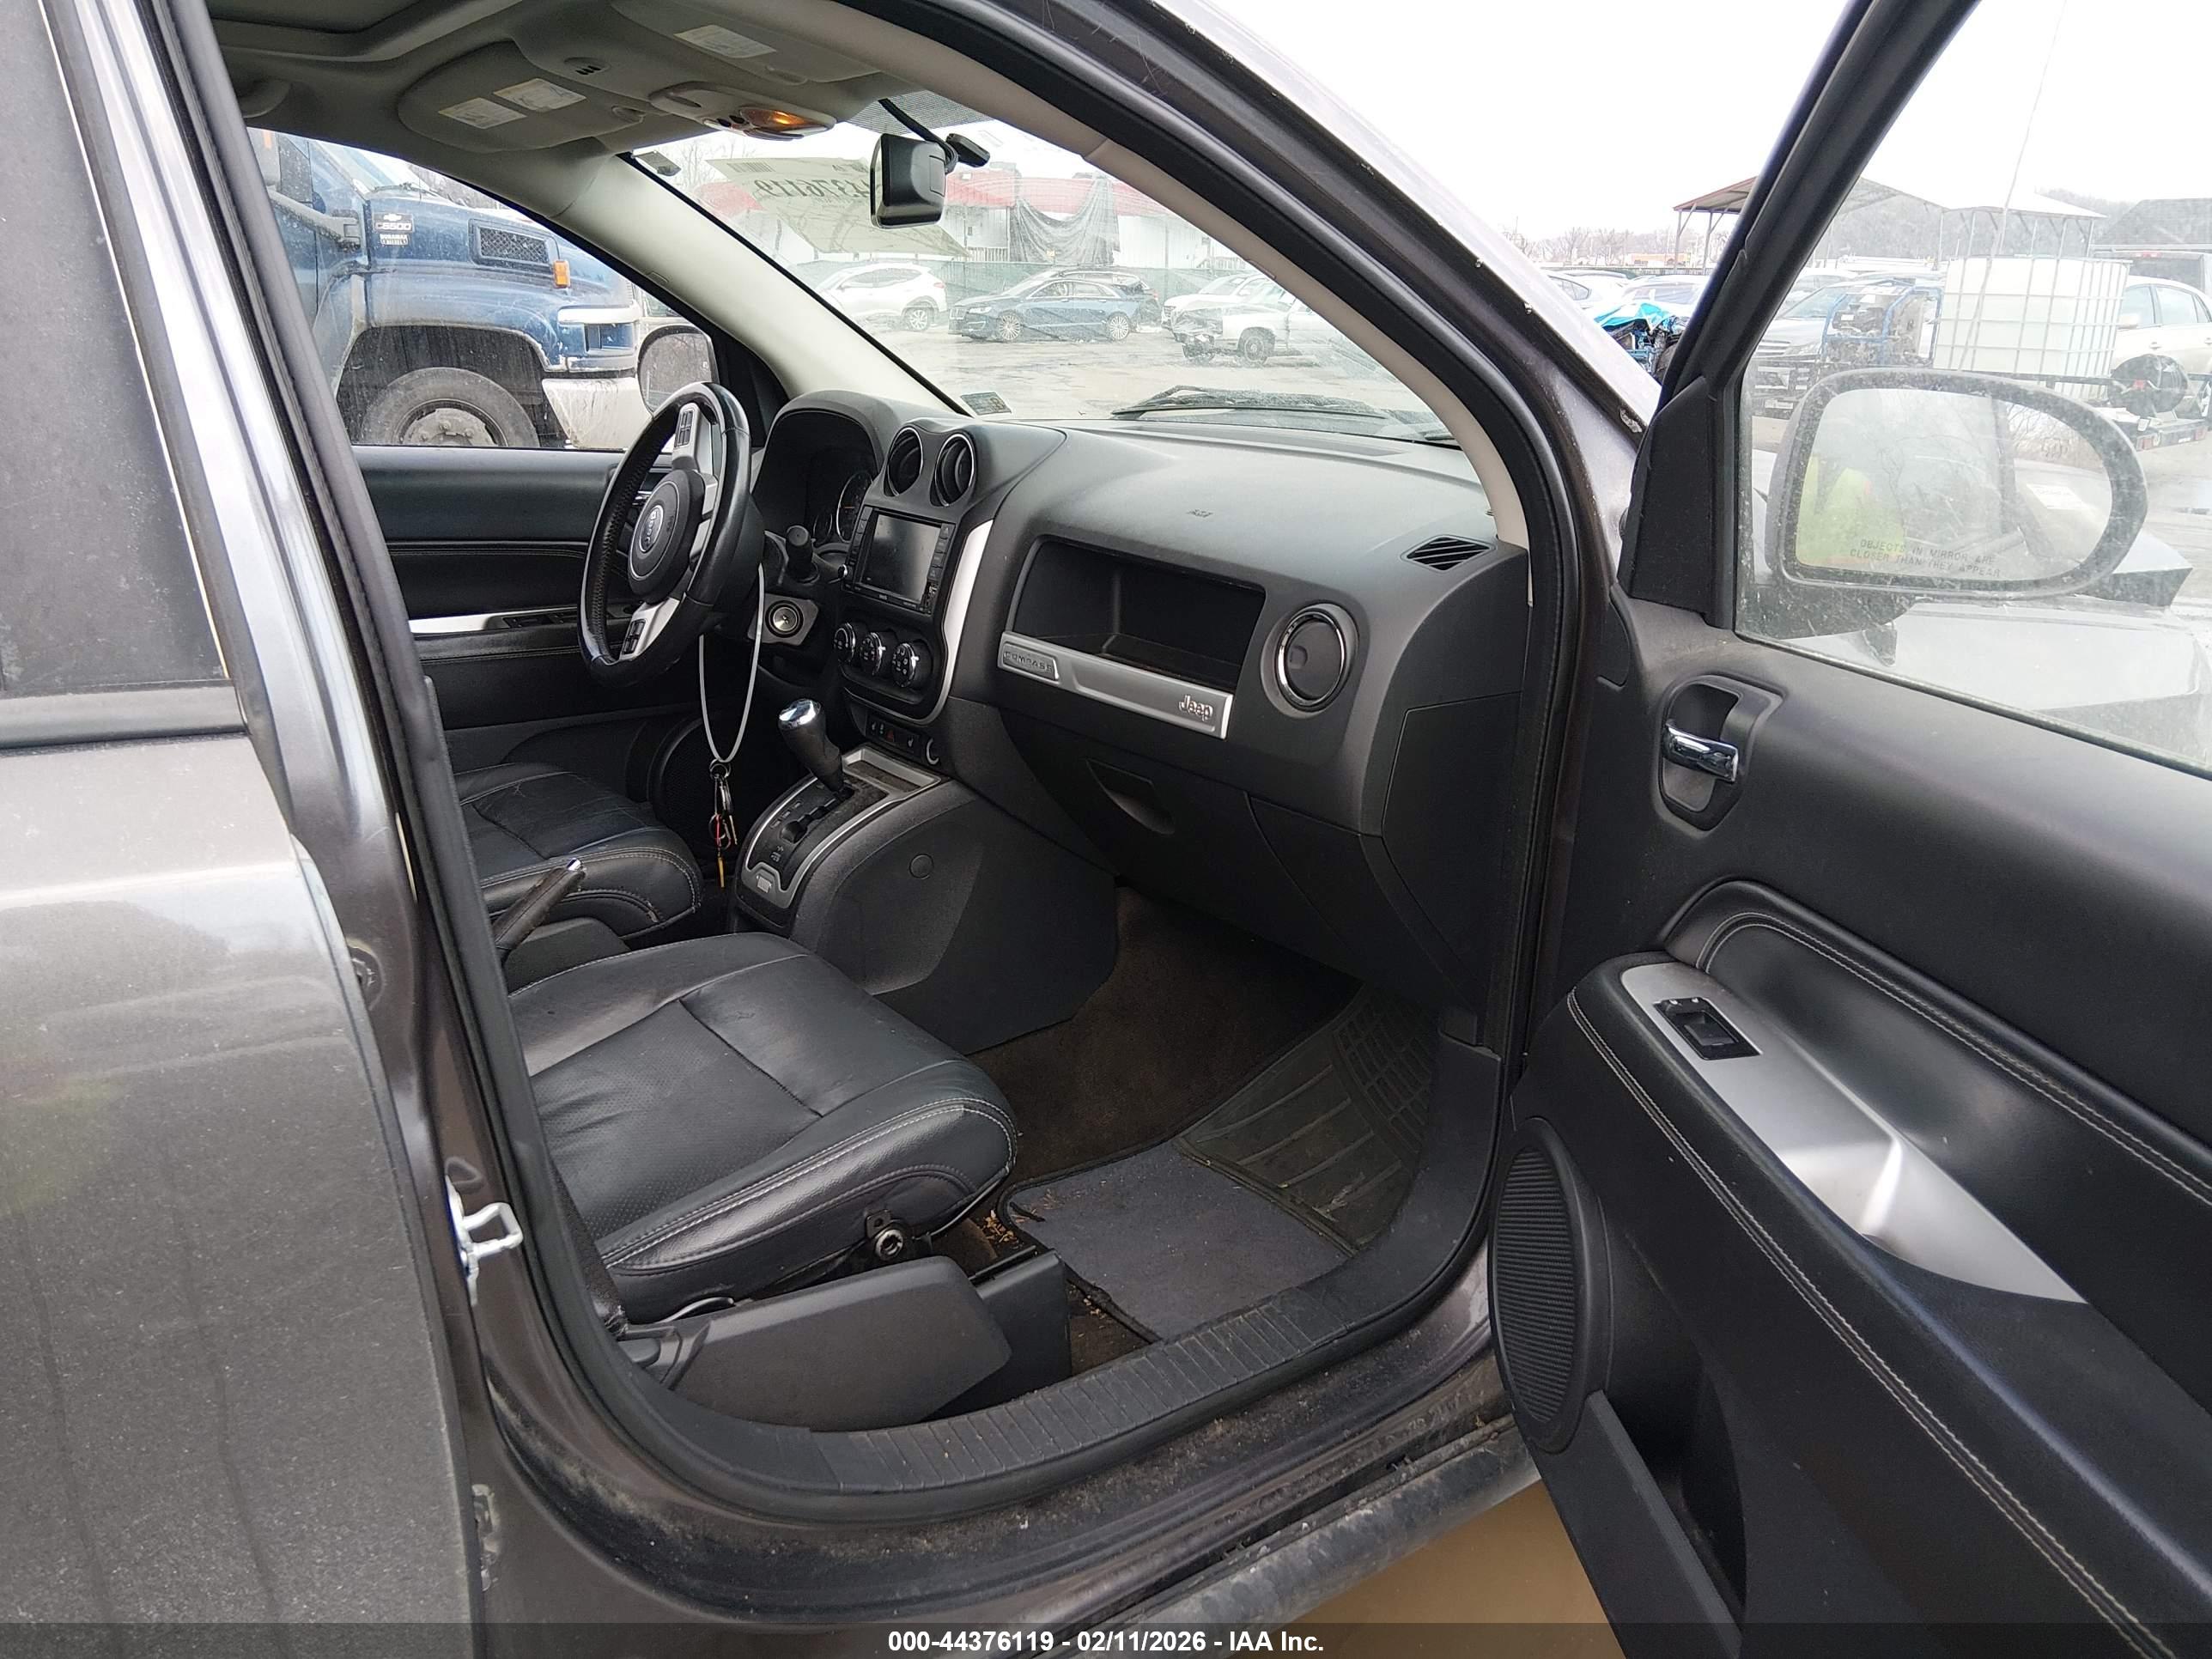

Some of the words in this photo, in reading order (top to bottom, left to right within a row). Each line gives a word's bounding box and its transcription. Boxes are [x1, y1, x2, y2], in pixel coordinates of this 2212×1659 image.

[1849, 549, 1890, 562] CLOSER
[1895, 555, 1923, 566] THAN
[1859, 538, 1906, 552] OBJECTS
[1911, 546, 1923, 556] IN
[1929, 549, 1968, 562] MIRROR
[1002, 651, 1053, 672] COMPASS
[1179, 695, 1213, 721] Jeep
